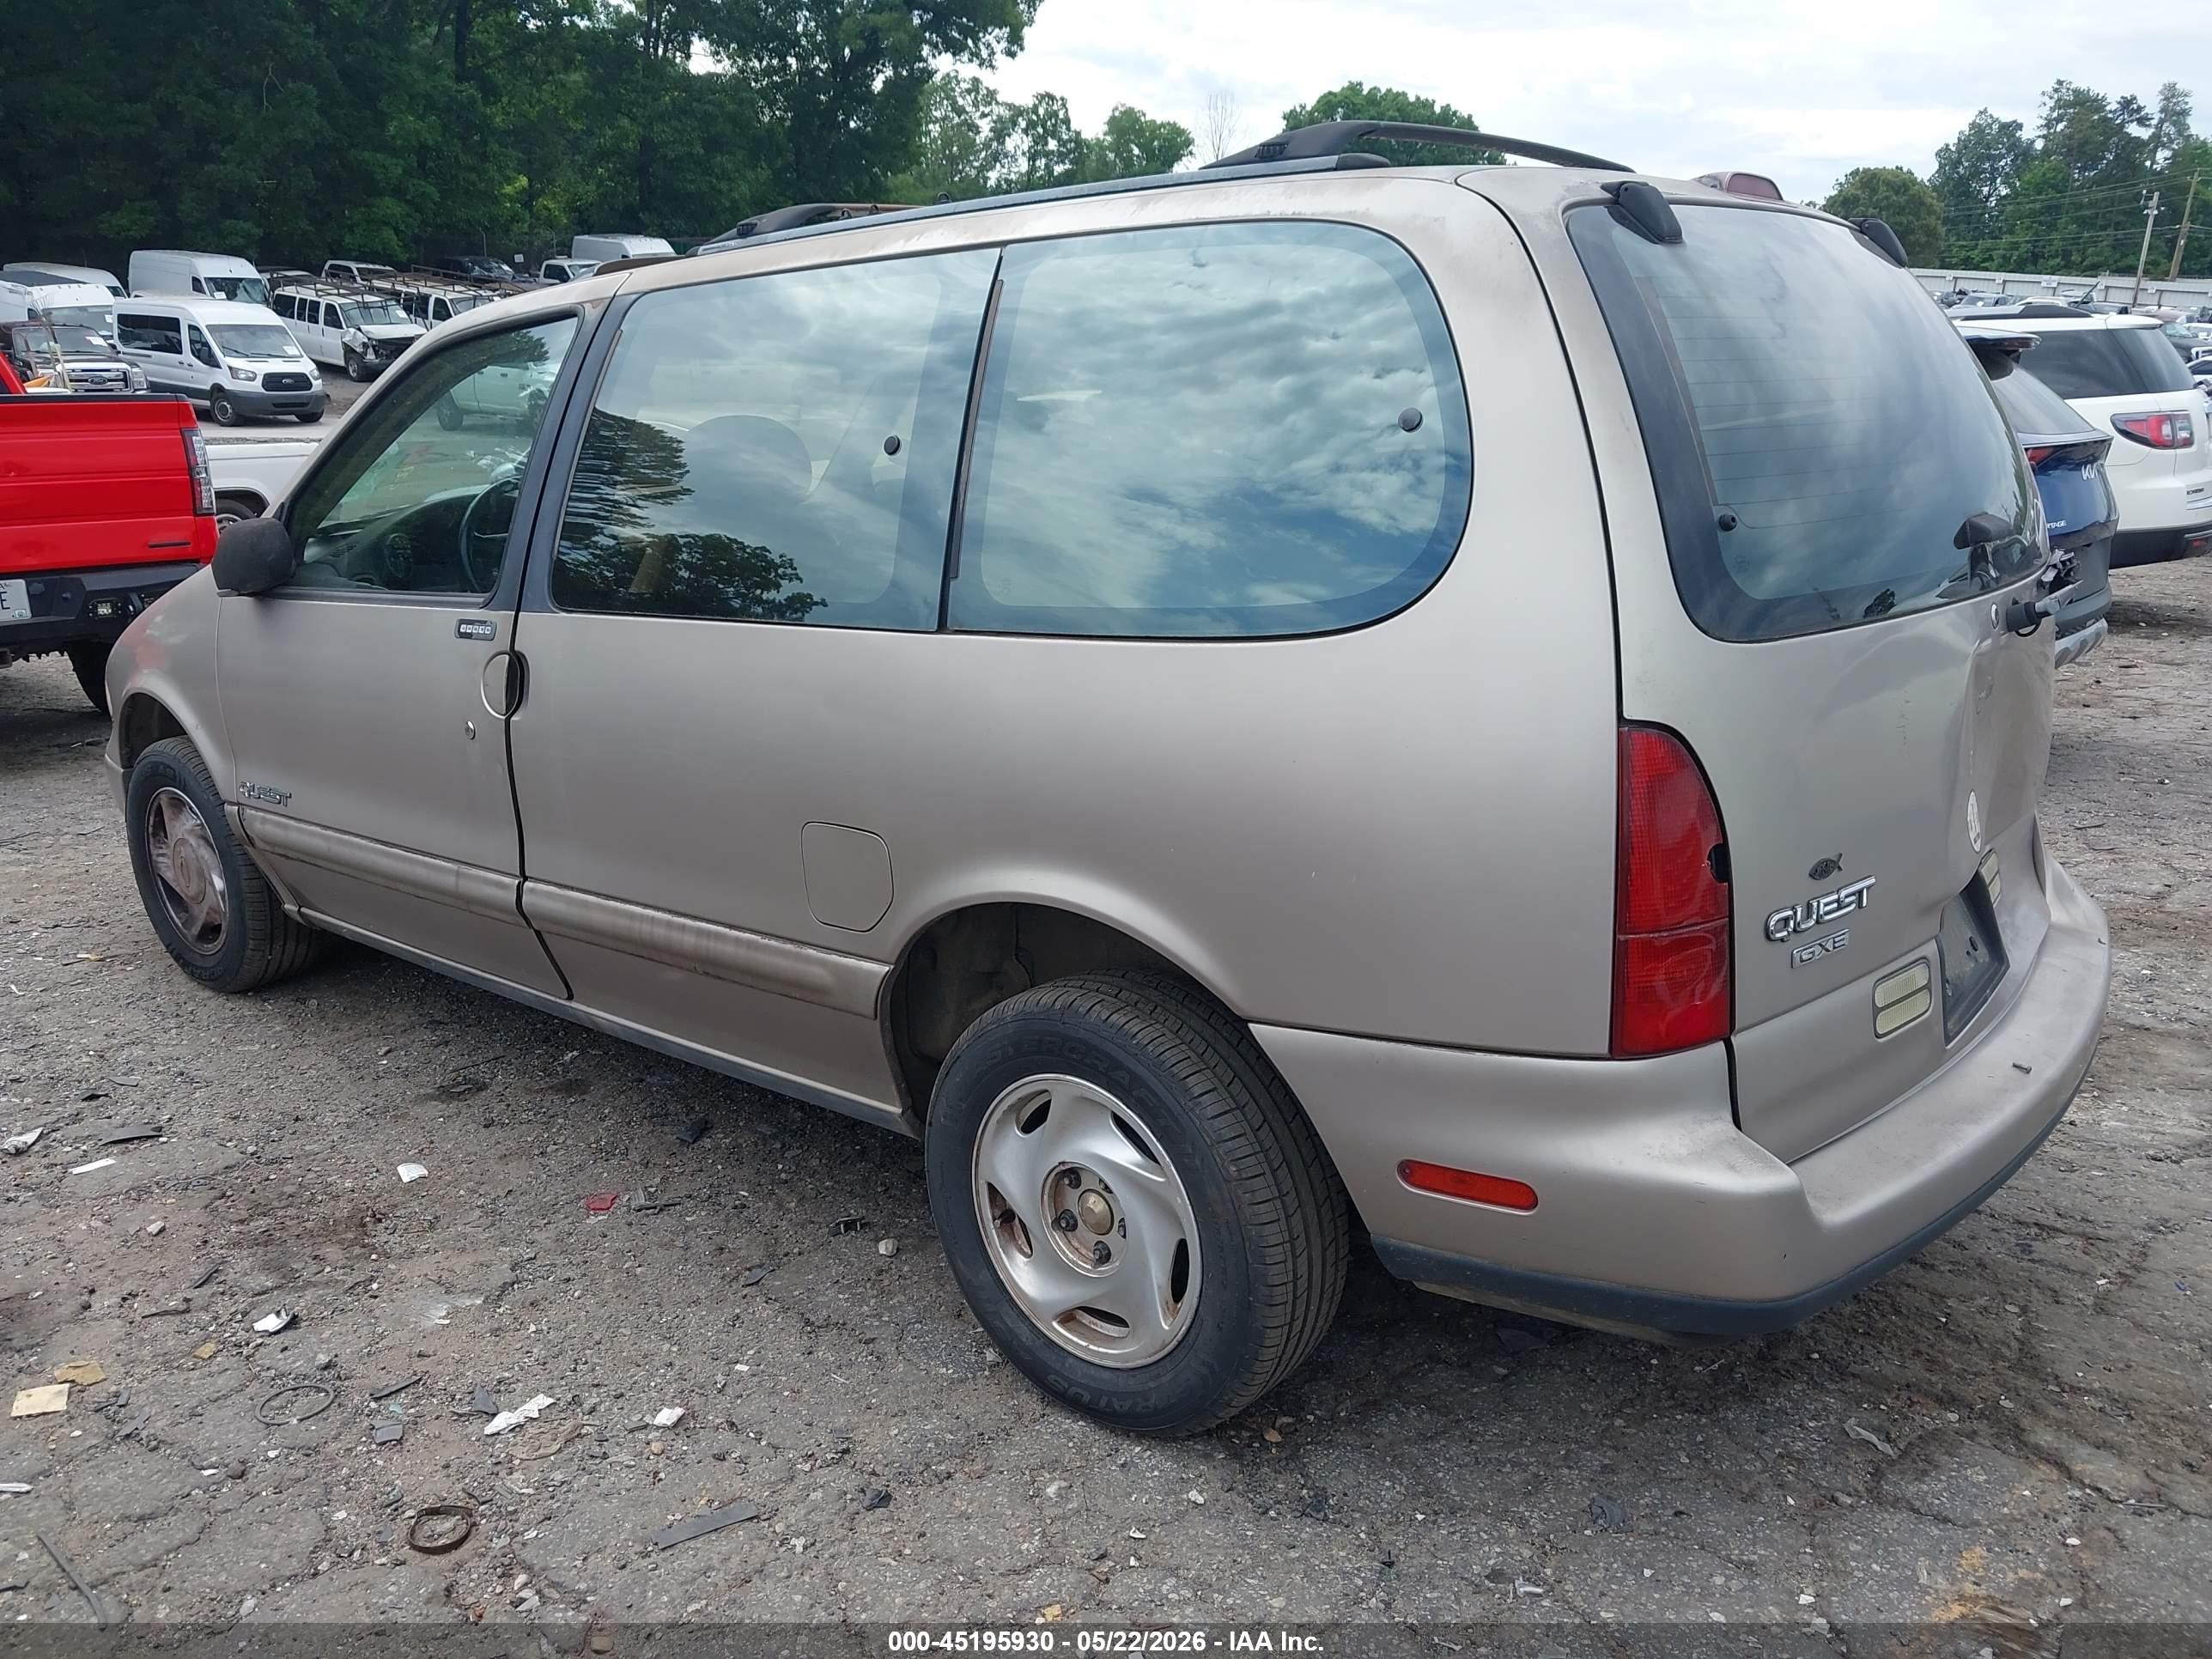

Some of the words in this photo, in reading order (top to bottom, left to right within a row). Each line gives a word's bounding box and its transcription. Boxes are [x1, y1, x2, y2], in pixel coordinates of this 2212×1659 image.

[240, 781, 292, 808] QUEST
[1765, 875, 1876, 943] QUEST
[1794, 928, 1850, 968] GXE
